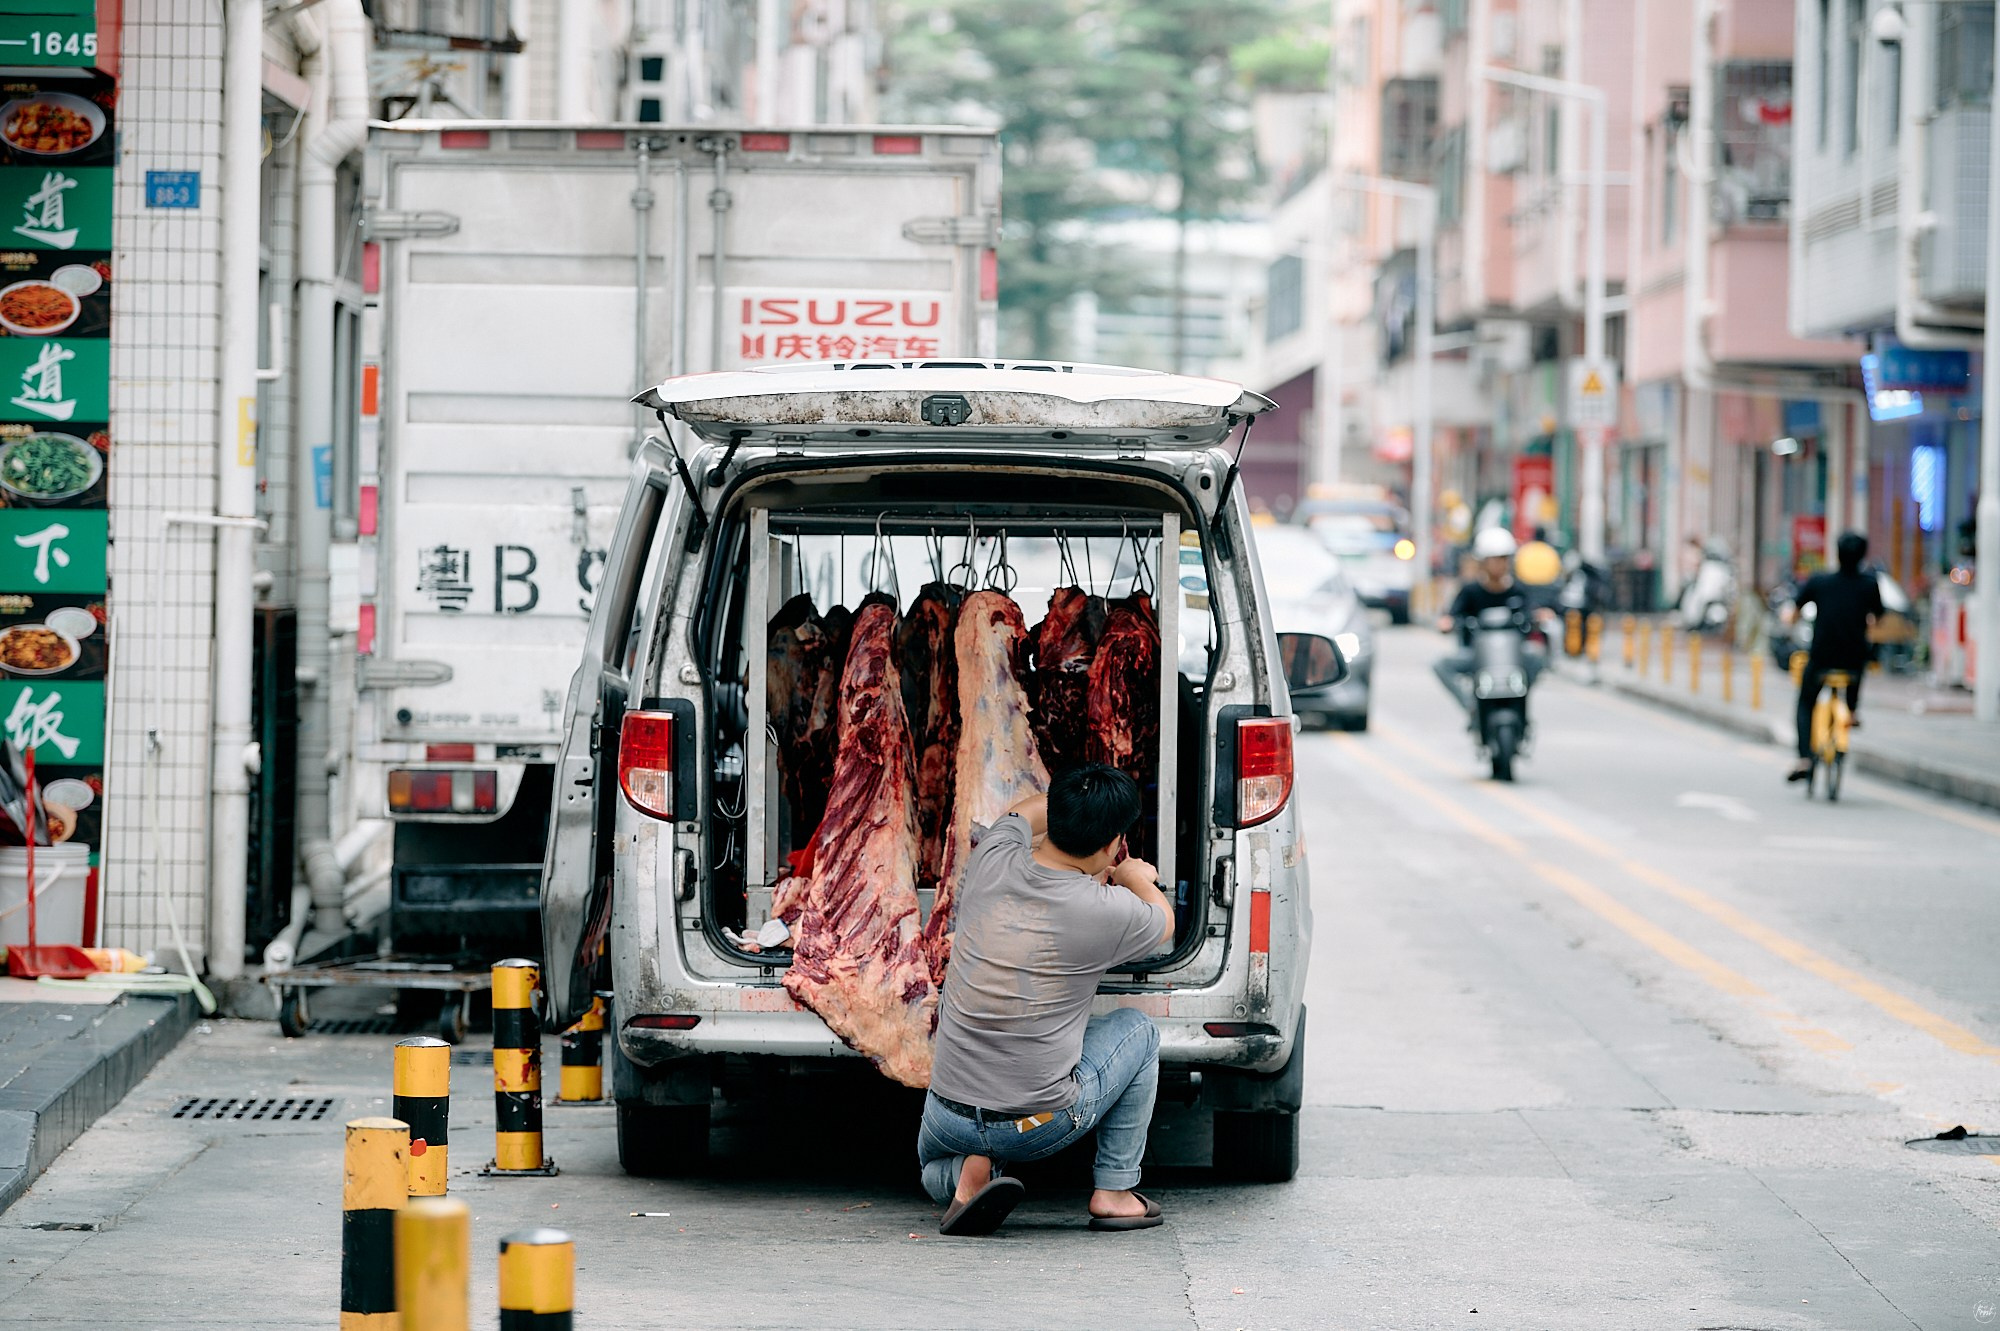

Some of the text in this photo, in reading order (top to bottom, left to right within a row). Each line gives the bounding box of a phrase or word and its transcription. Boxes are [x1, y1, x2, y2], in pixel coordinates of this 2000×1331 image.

[741, 298, 940, 327] ISUZU
[773, 334, 939, 359] 庆铃汽车
